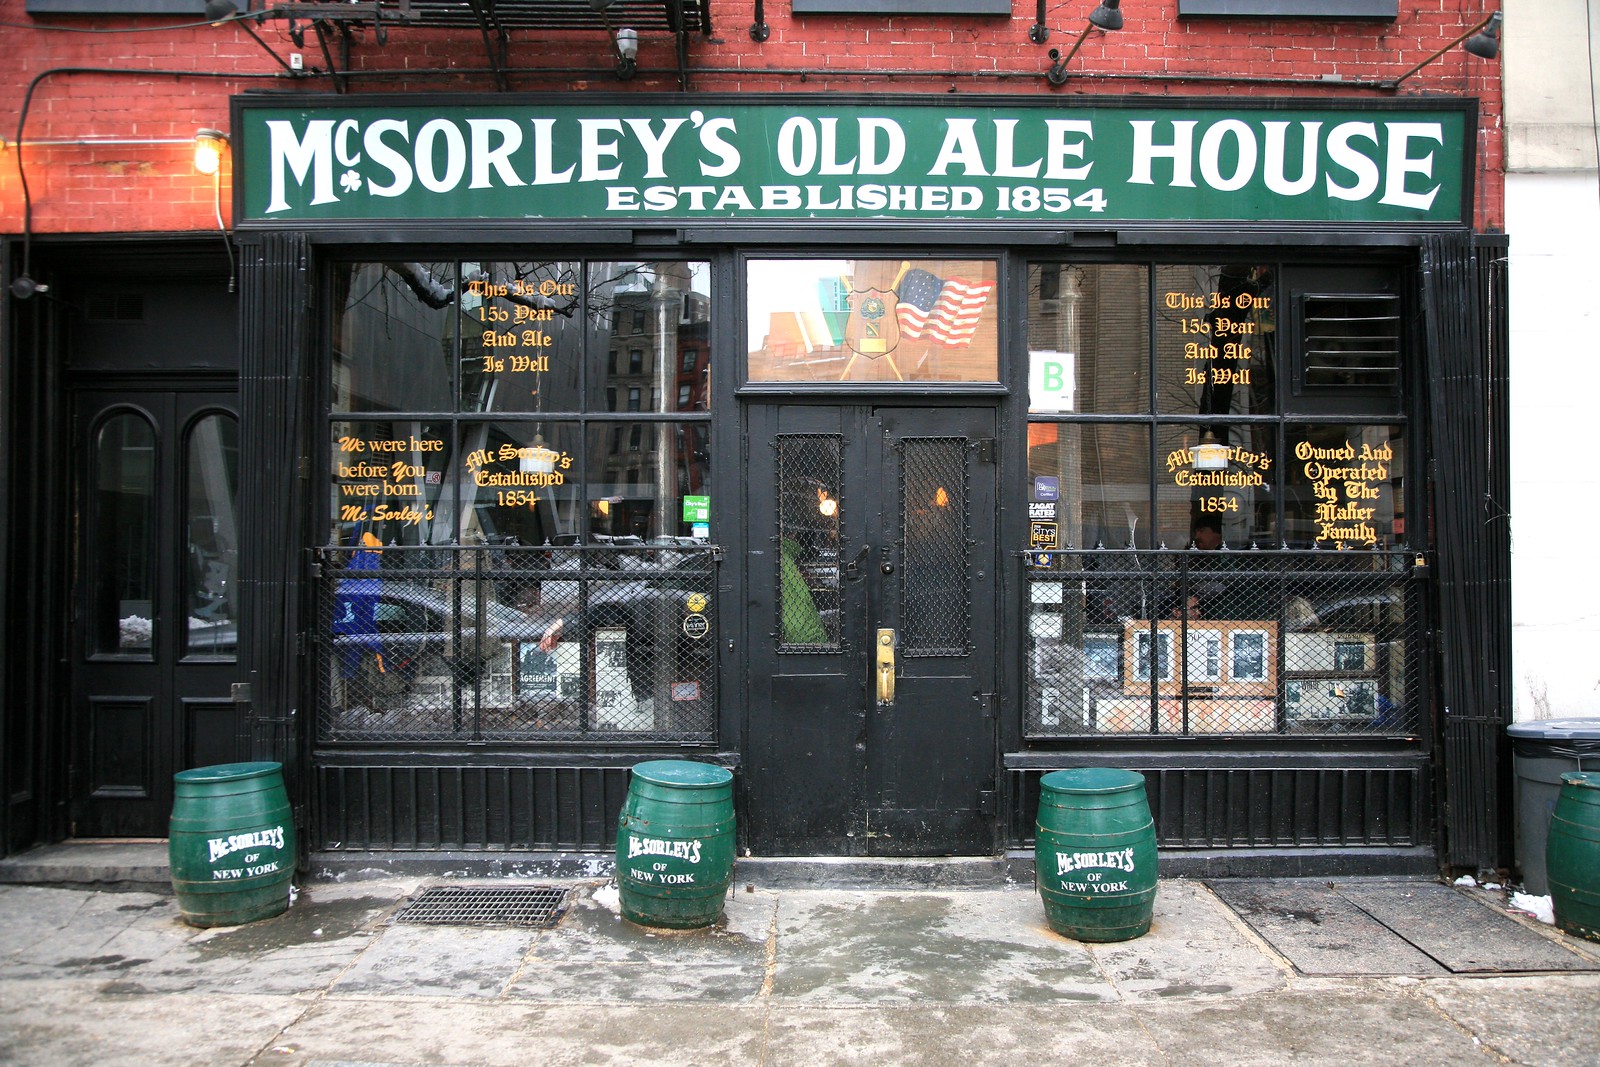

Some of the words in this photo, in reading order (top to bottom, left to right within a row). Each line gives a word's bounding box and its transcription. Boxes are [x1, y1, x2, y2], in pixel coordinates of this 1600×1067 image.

[777, 116, 906, 177] OLD
[926, 117, 1095, 181] ALE
[1126, 118, 1444, 212] HOUSE
[604, 184, 984, 212] ESTABLISHED
[995, 185, 1108, 213] 1854
[468, 280, 508, 299] This
[513, 279, 534, 296] Is
[539, 279, 575, 296] Our
[1164, 292, 1205, 312] This
[1209, 291, 1231, 309] Is
[1235, 292, 1271, 309] Our
[480, 306, 509, 322] 156
[513, 304, 554, 325] Year
[1180, 318, 1212, 334] 156
[1214, 317, 1255, 337] Year
[482, 330, 517, 347] And
[521, 329, 552, 347] Ale
[1184, 342, 1219, 359] And
[1223, 342, 1252, 360] Ale
[482, 355, 504, 373] Is
[509, 355, 550, 372] Well
[1043, 361, 1064, 391] B
[1184, 367, 1206, 385] Is
[1211, 367, 1251, 385] Well
[338, 436, 366, 452] We
[368, 440, 407, 452] were
[409, 435, 444, 452] here
[1294, 439, 1356, 461] Owned
[1357, 440, 1393, 462] And
[465, 448, 496, 473] Mc
[498, 443, 574, 469] Sorley's
[1165, 448, 1195, 473] Mc
[338, 461, 388, 478] before
[391, 461, 426, 483] You
[474, 470, 564, 489] Established
[1174, 470, 1263, 490] Established
[1303, 461, 1387, 486] Operated
[341, 484, 380, 496] were
[383, 480, 423, 496] born.
[1312, 480, 1338, 504] By
[1343, 480, 1381, 500] The
[496, 490, 542, 506] 1854
[1198, 496, 1239, 513] 1854
[340, 504, 368, 522] Mc
[371, 504, 434, 526] Sorley's
[1033, 533, 1056, 542] BEST
[1315, 521, 1377, 546] Family
[245, 854, 259, 862] OF
[653, 863, 667, 871] OF
[213, 869, 243, 879] NEW
[247, 862, 278, 876] YORK
[631, 868, 654, 881] NEW
[659, 874, 694, 883] YORK
[1087, 873, 1102, 881] OF
[1061, 881, 1087, 891] NEW
[1092, 881, 1127, 892] YORK
